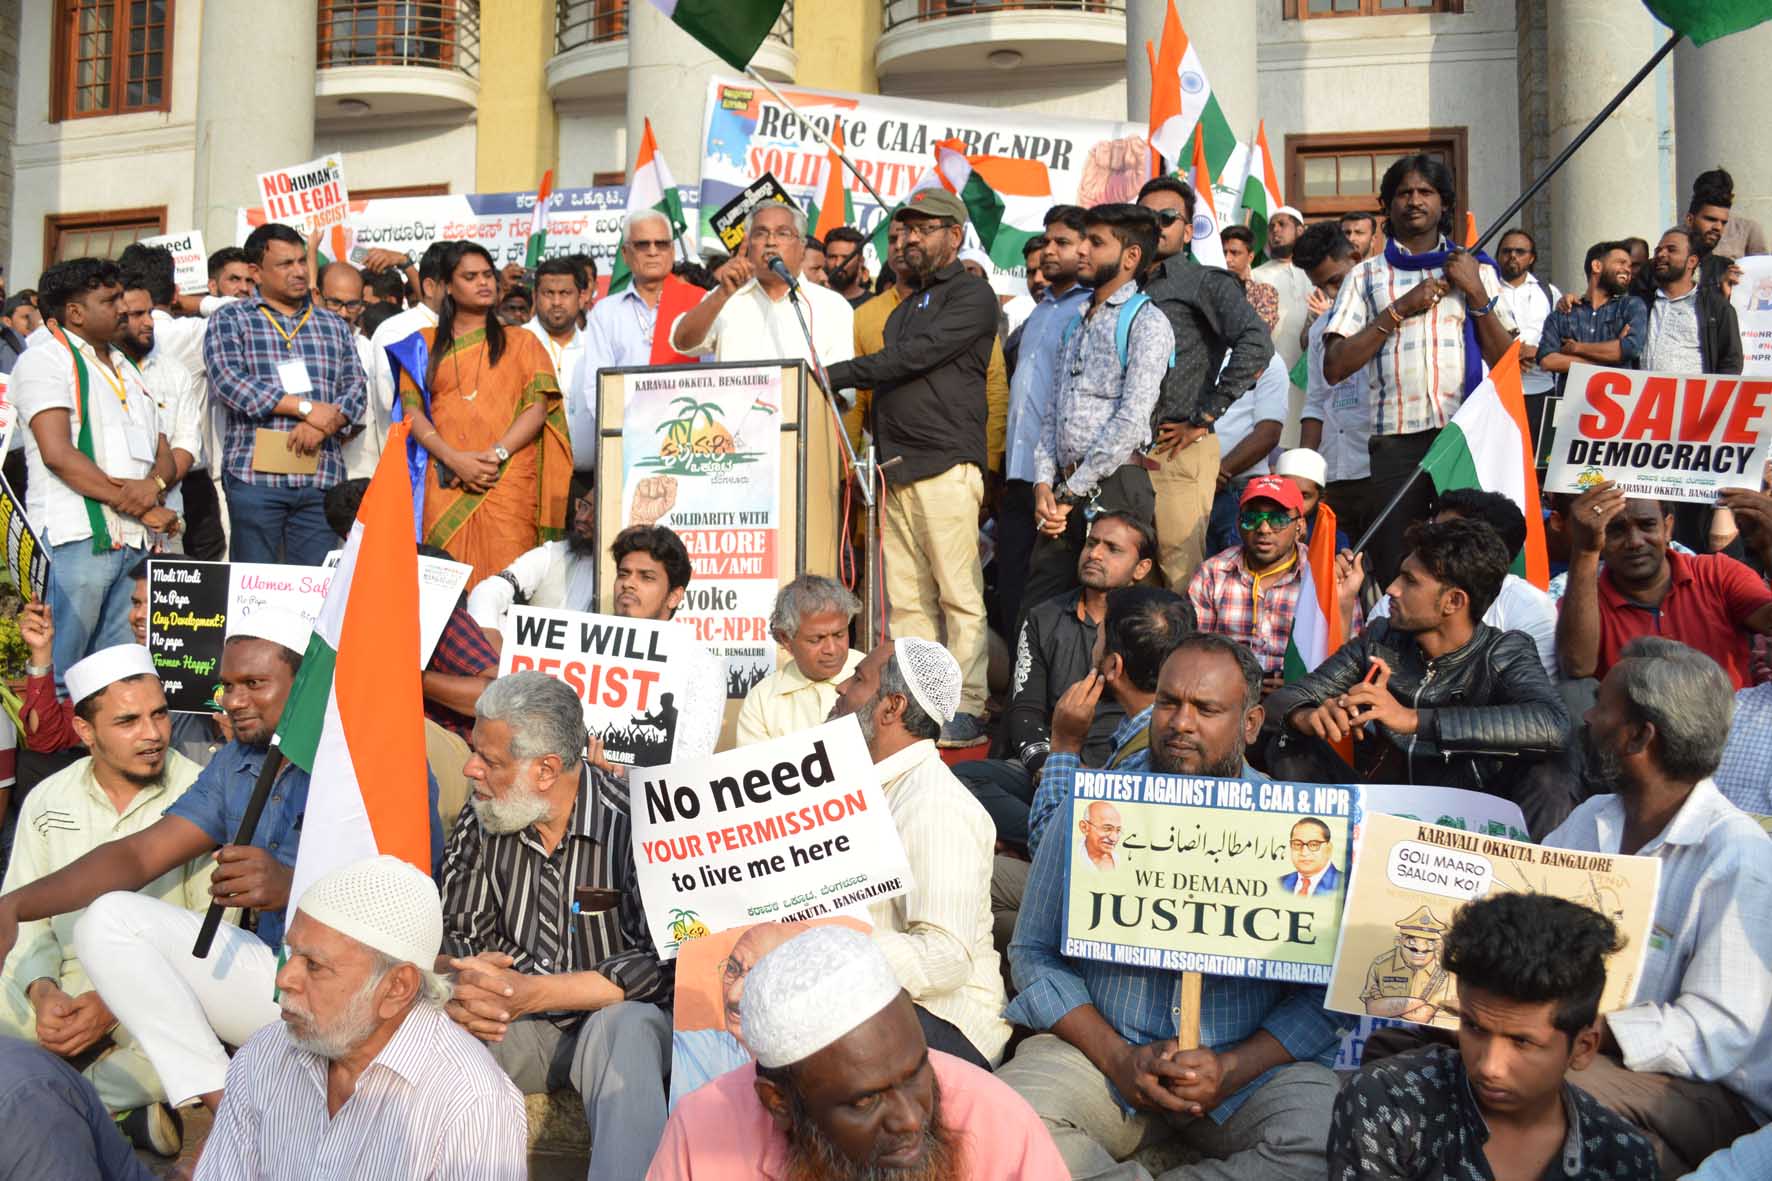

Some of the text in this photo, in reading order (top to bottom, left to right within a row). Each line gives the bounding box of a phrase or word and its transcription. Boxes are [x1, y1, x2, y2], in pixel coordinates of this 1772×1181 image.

[758, 104, 867, 147] Revoke
[263, 172, 291, 197] NO
[290, 167, 331, 192] HUMAN
[747, 146, 926, 197] SOLIRITY
[268, 181, 343, 219] ILLEGAL
[635, 379, 676, 391] KARAVALI
[718, 374, 769, 387] BENGALURU
[1578, 371, 1772, 444] SAVE
[1566, 439, 1756, 474] DEMOCRACY
[670, 511, 768, 526] SOLIDARITY WITH
[679, 531, 766, 554] GALORE
[690, 557, 762, 575] MIA/AMU
[241, 574, 294, 593] Women
[153, 611, 171, 631] Any
[152, 634, 164, 646] No
[516, 615, 668, 663] WE WILL
[183, 656, 216, 676] Happy?
[644, 739, 835, 825] No need
[1074, 771, 1350, 816] PROTEST AGAINST NRC, CAA & NPR
[643, 789, 868, 864] YOUR PERMISSION
[671, 834, 851, 892] to live me here
[1398, 848, 1485, 877] GOLI MAARO
[1416, 825, 1479, 854] KARAVALI
[1481, 838, 1535, 865] OKKUTA,
[1539, 851, 1613, 873] BANGALORE
[832, 876, 903, 910] BANGALORE
[1135, 869, 1268, 897] WE DEMAND
[1396, 863, 1480, 893] SAALON KO!
[1088, 891, 1317, 945] JUSTICE
[1066, 938, 1114, 961] CENTRAL
[1115, 945, 1161, 968] MUSLIM
[1163, 950, 1246, 977] ASSOCIATION
[1247, 960, 1265, 979] OF
